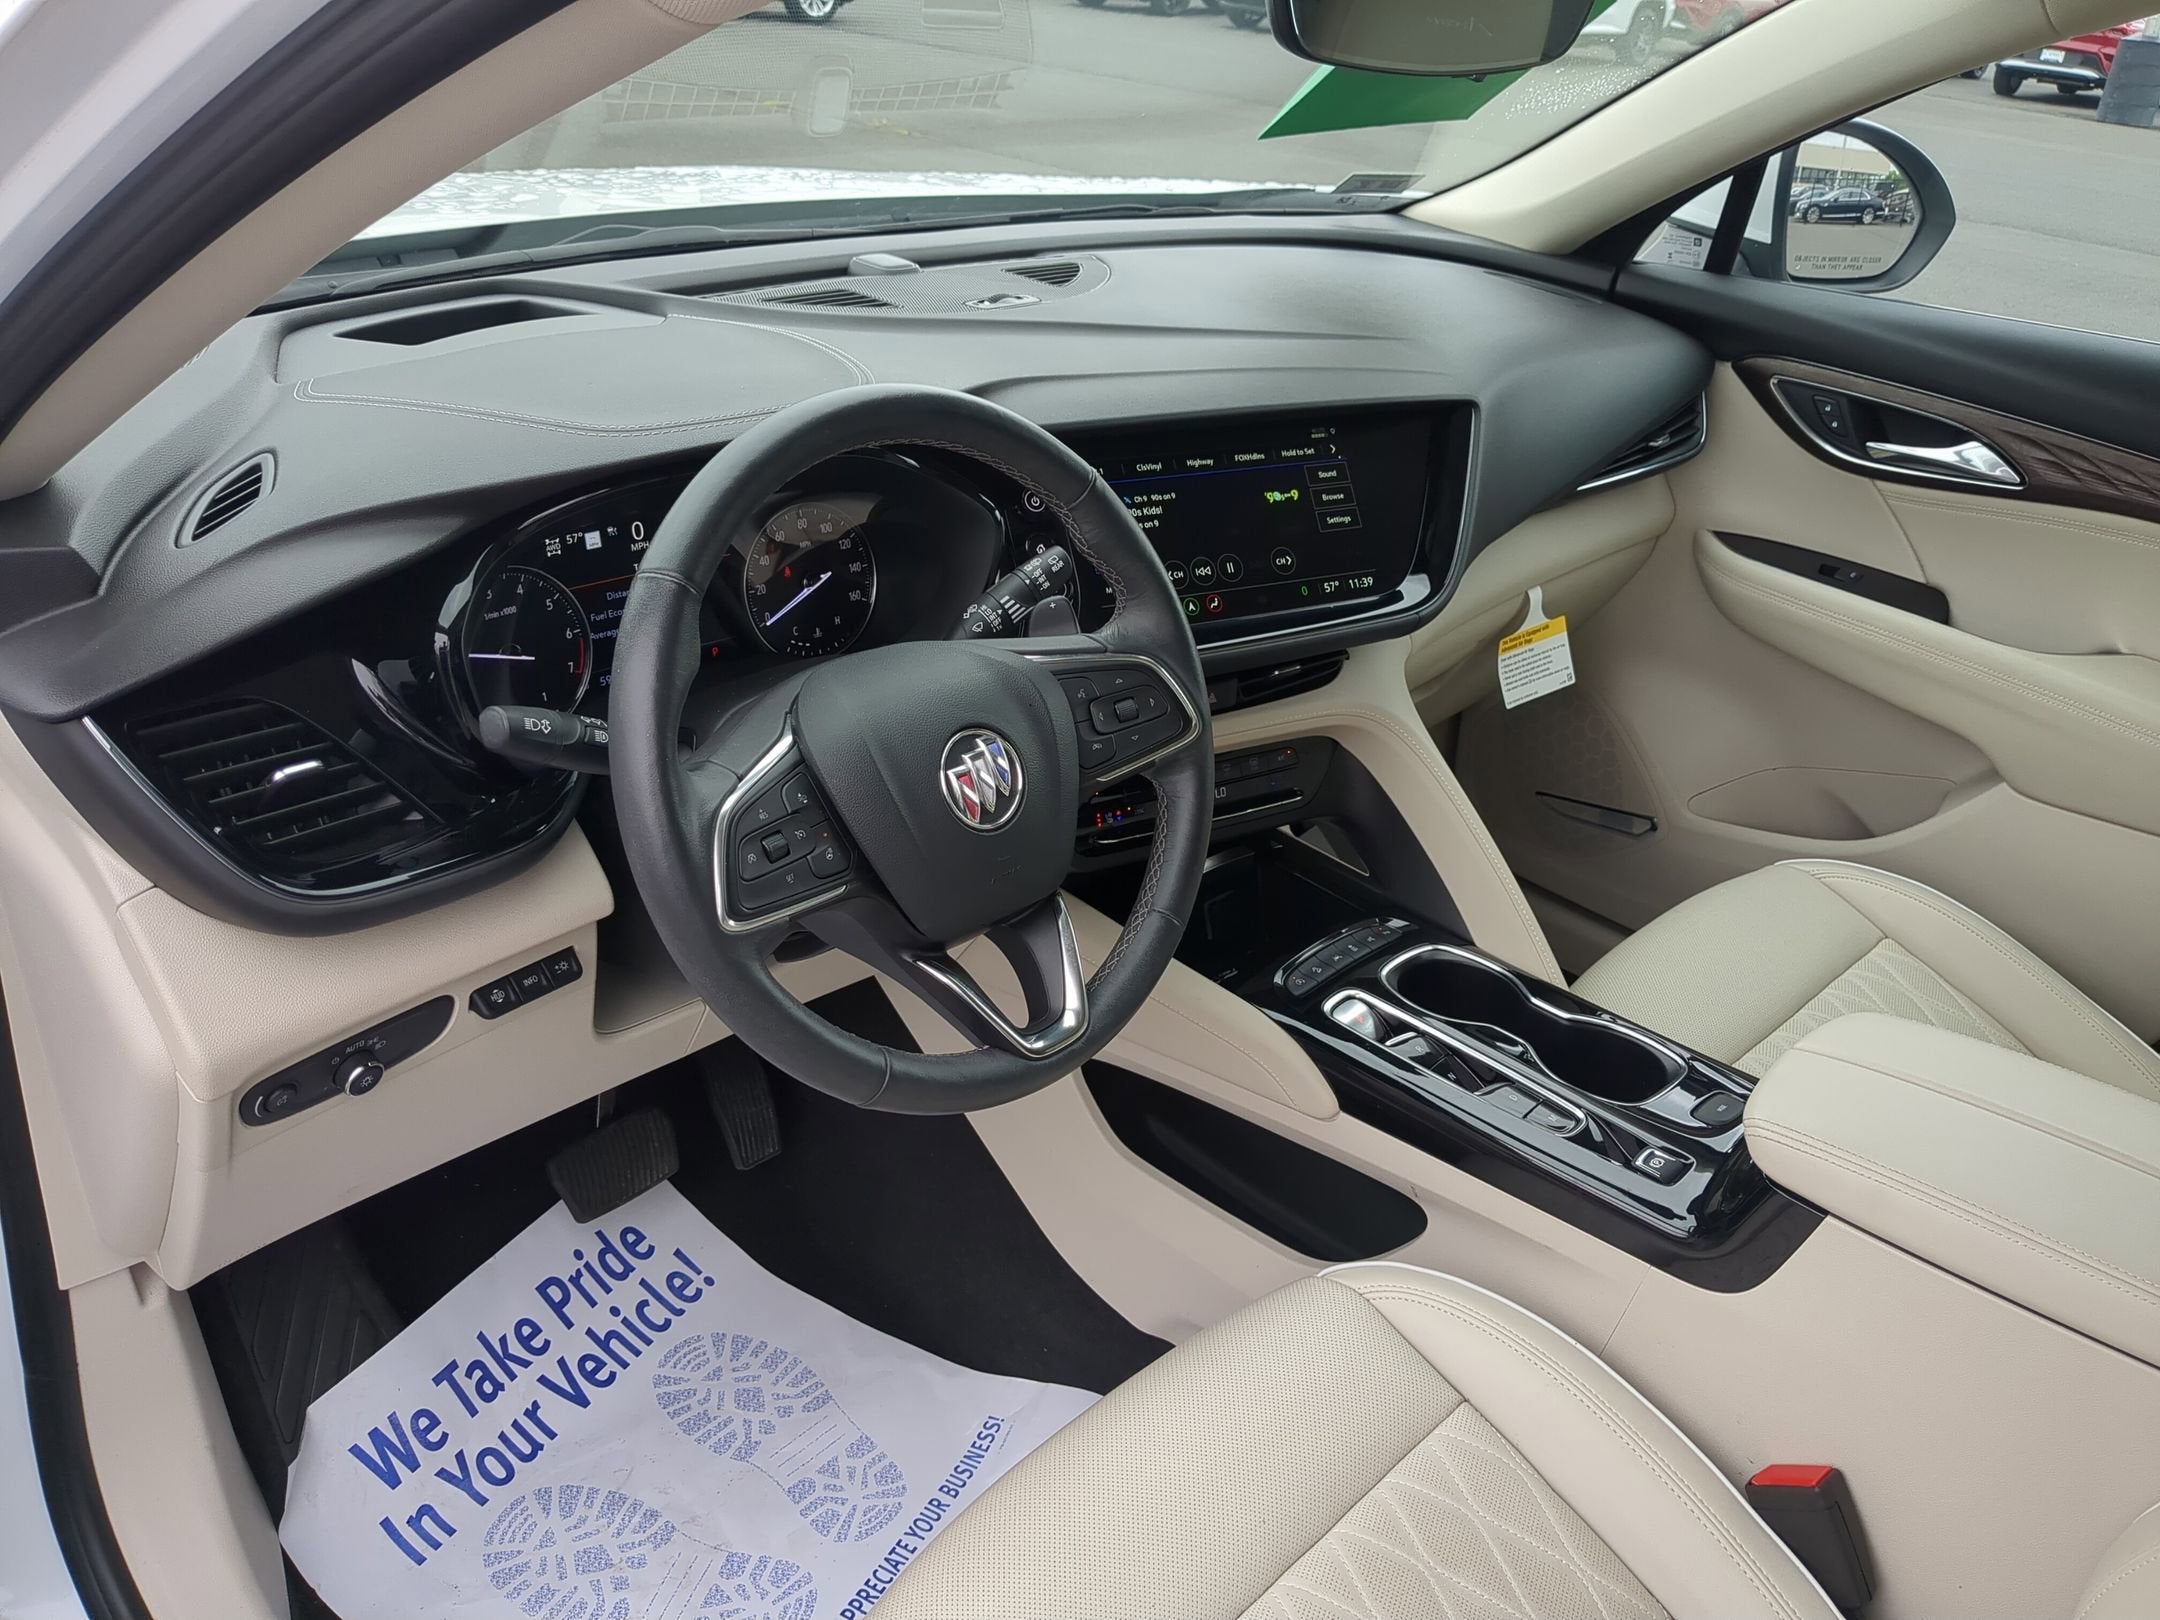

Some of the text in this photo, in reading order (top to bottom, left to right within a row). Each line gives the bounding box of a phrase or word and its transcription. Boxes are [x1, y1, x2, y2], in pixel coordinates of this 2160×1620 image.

[1281, 449, 1296, 457] Hold
[1304, 447, 1315, 455] Set
[1186, 458, 1214, 468] Highway
[1318, 470, 1337, 478] Sound
[1134, 495, 1142, 503] Ch
[1322, 492, 1344, 501] Browse
[1143, 505, 1163, 516] Kids!
[1153, 519, 1159, 527] 9
[1326, 515, 1351, 525] Settings
[631, 521, 644, 540] 0
[820, 522, 833, 533] 100
[566, 531, 583, 544] 57°
[775, 530, 785, 542] 60
[545, 543, 561, 552] AWD
[630, 541, 649, 552] MPH
[838, 538, 851, 550] 120
[759, 556, 770, 566] 40
[848, 561, 862, 573] 140
[1173, 570, 1184, 579] CH
[1323, 581, 1339, 593] 57°
[1348, 576, 1374, 589] 11:39
[516, 583, 524, 595] 4
[755, 584, 766, 595] 20
[848, 590, 861, 601] 160
[546, 601, 553, 611] 5
[590, 610, 608, 622] Fuel
[764, 611, 771, 622] 0
[834, 616, 841, 625] H
[565, 628, 573, 639] 6
[793, 626, 799, 636] C
[567, 662, 575, 673] 7
[541, 692, 548, 702] 1
[522, 975, 539, 987] INFO
[489, 989, 505, 1001] HUD
[345, 1040, 365, 1054] AUTO
[347, 1225, 656, 1490] We Take Pride
[378, 1248, 716, 1567] In Your Vehicle!
[904, 1497, 951, 1540] YOUR
[938, 1415, 1005, 1499] BUSINESS!
